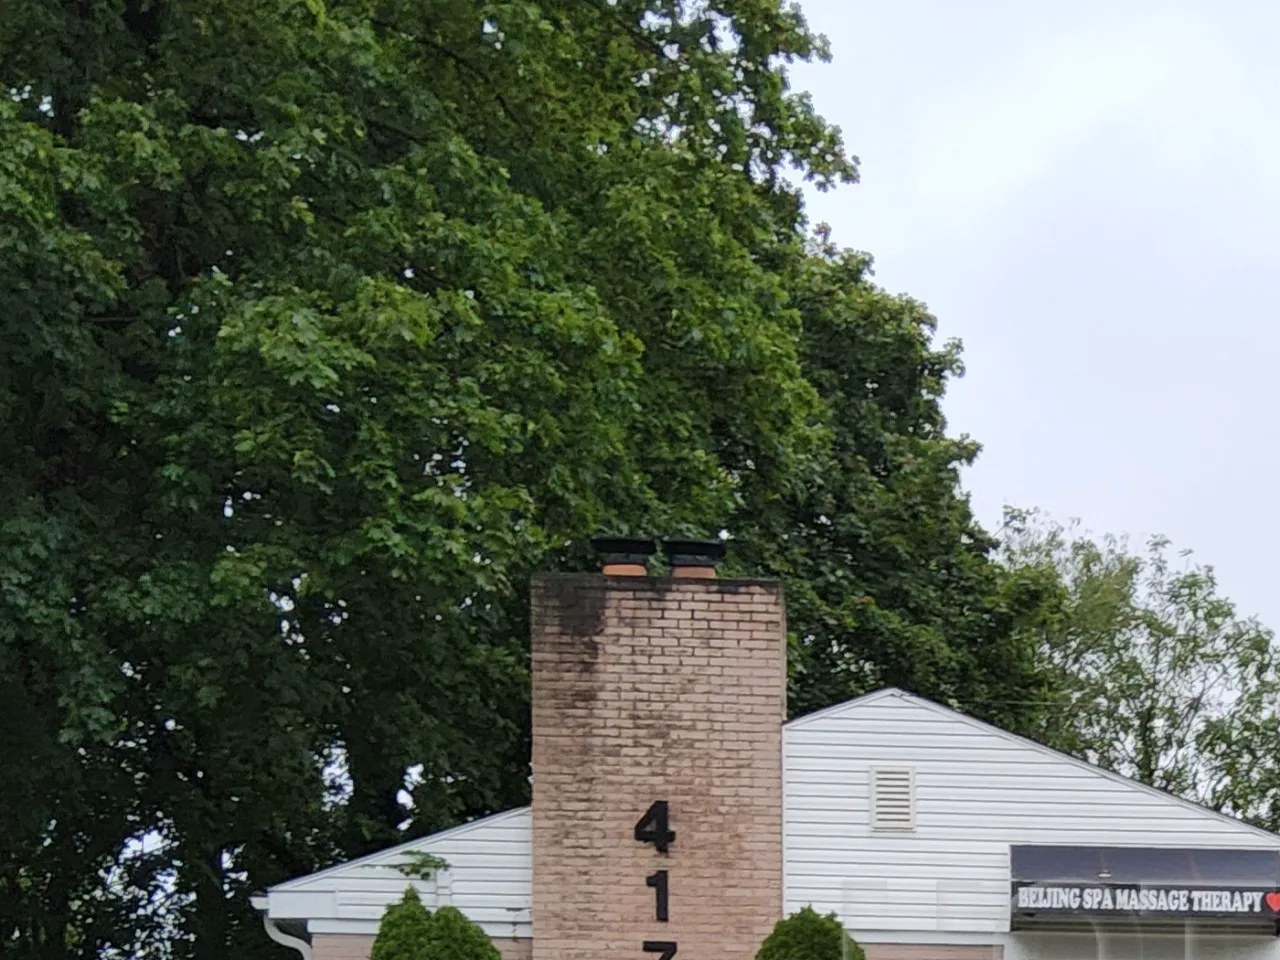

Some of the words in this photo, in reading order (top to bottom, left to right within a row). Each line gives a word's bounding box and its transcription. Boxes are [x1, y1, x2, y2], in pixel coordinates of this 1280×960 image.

[1083, 888, 1114, 910] SPA
[1115, 889, 1189, 911] MASSAGE
[1191, 891, 1264, 912] THERAPY
